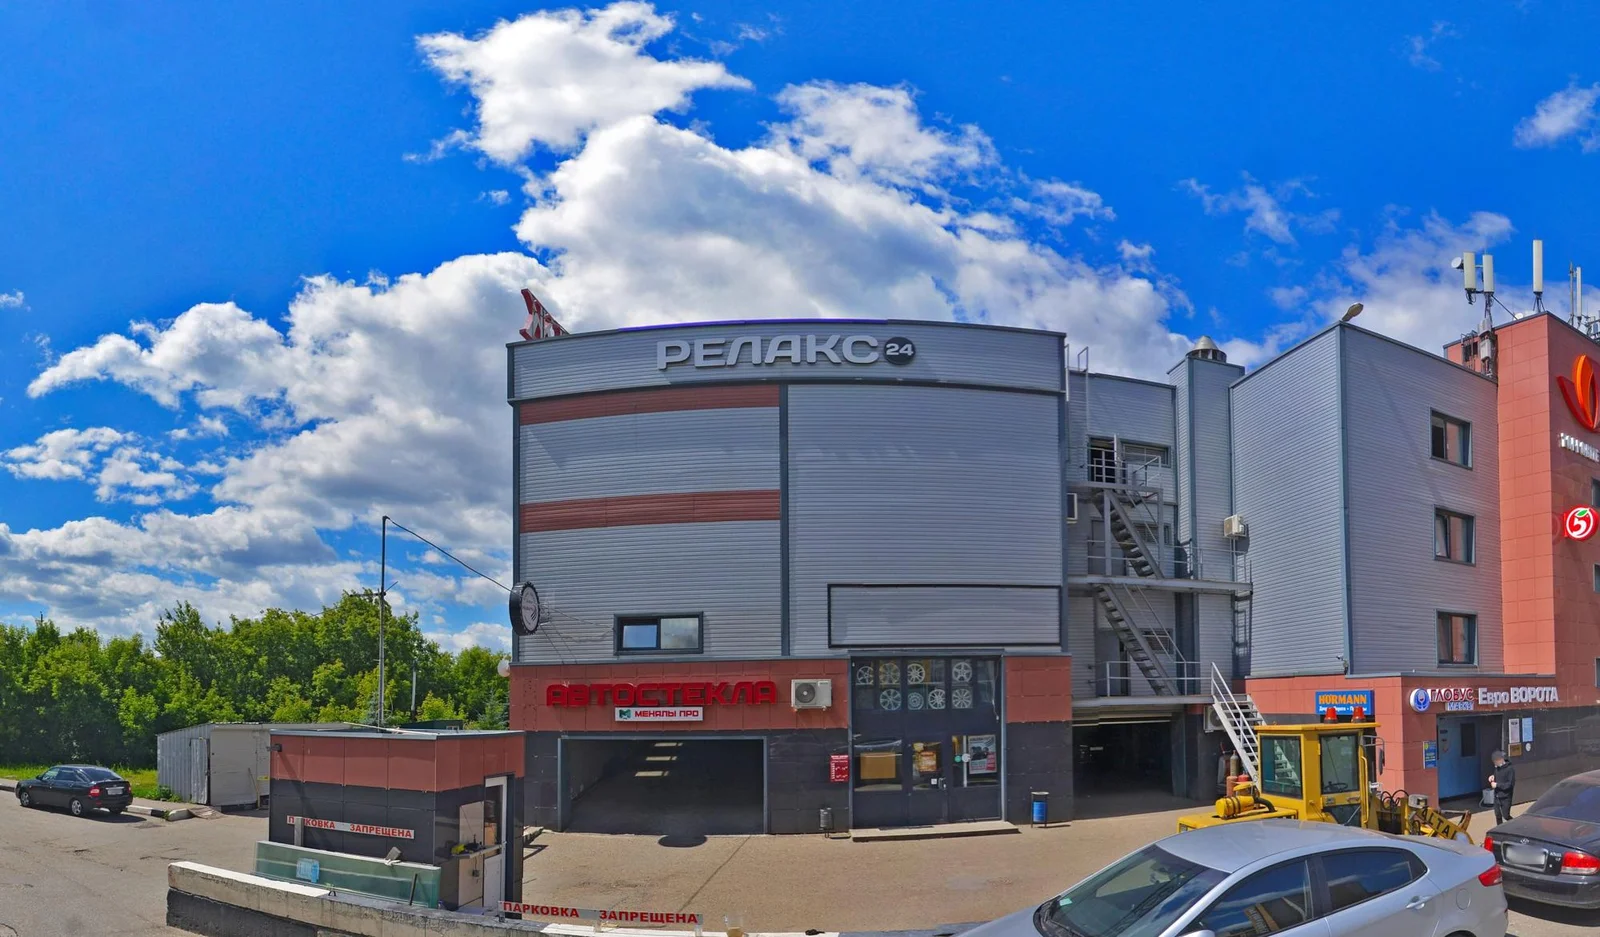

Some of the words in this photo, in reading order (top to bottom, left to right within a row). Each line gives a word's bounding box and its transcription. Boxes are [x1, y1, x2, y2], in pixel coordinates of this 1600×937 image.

[656, 334, 880, 371] РЕЛАКС
[885, 343, 914, 356] 24
[546, 680, 778, 708] АВТОСТЕКЛА
[1430, 688, 1474, 702] ГЛОБУС
[1478, 687, 1509, 707] Евро
[1510, 686, 1559, 704] ВОРОТА
[288, 816, 336, 829] ПКОВКА
[349, 823, 412, 838] ЗАПРЕЩЕНА
[503, 902, 580, 918] ПАРКОВКА
[599, 910, 699, 924] ЗАПРЕЩЕНА
